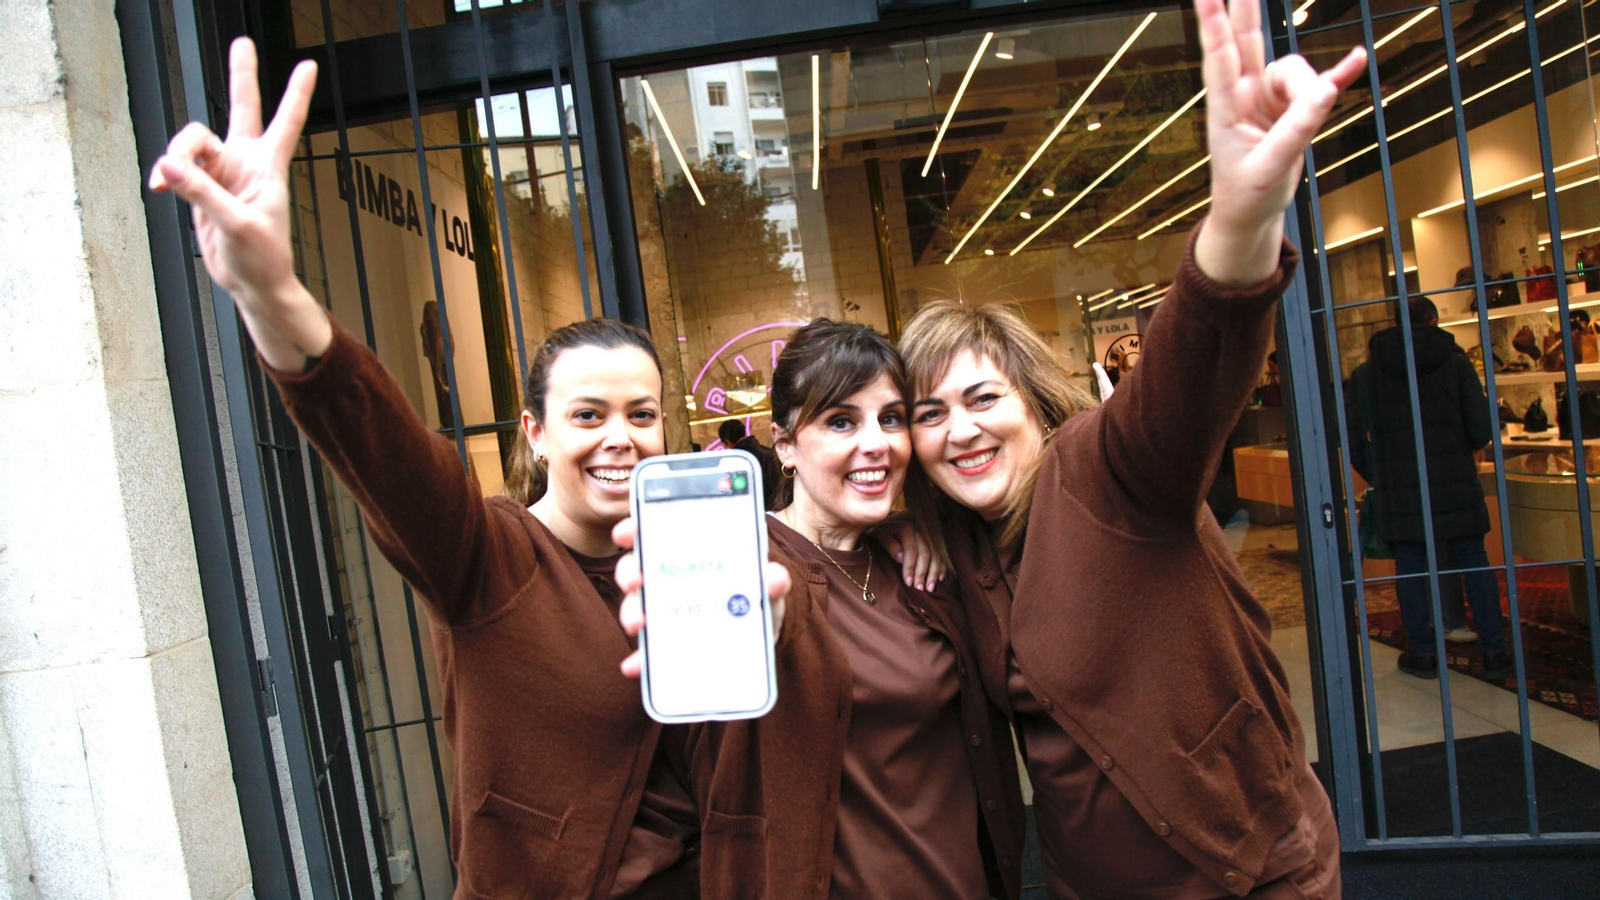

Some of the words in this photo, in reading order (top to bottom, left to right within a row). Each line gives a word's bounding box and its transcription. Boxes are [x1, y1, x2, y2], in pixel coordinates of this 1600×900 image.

[334, 147, 423, 237] BIMBA
[442, 208, 475, 262] LOL
[1106, 323, 1130, 334] LOLA
